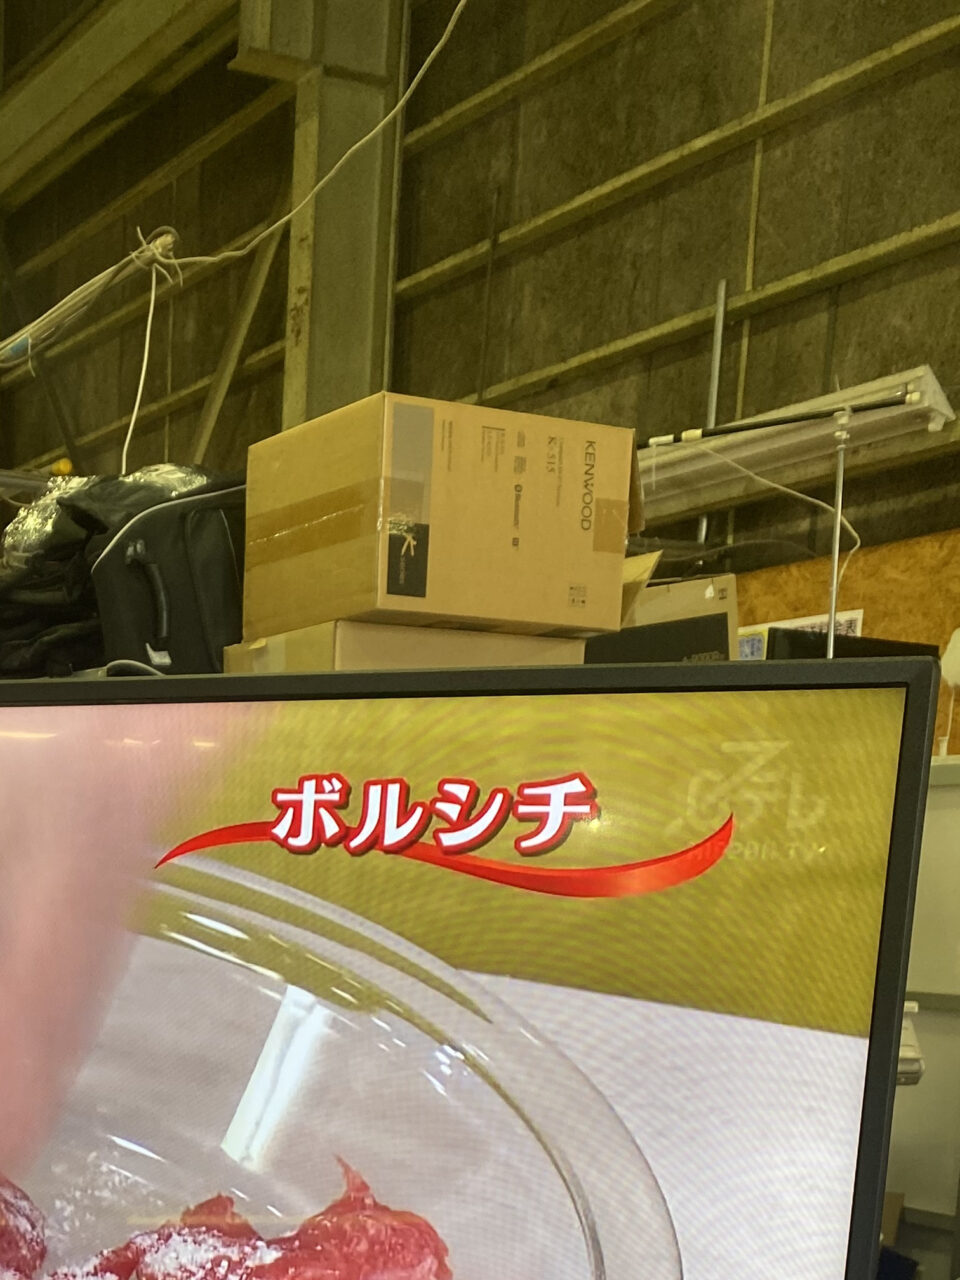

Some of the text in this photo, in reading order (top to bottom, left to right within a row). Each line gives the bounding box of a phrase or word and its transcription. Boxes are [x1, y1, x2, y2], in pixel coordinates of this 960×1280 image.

[581, 440, 596, 531] KENWOOD
[271, 772, 599, 857] ボルシチ
